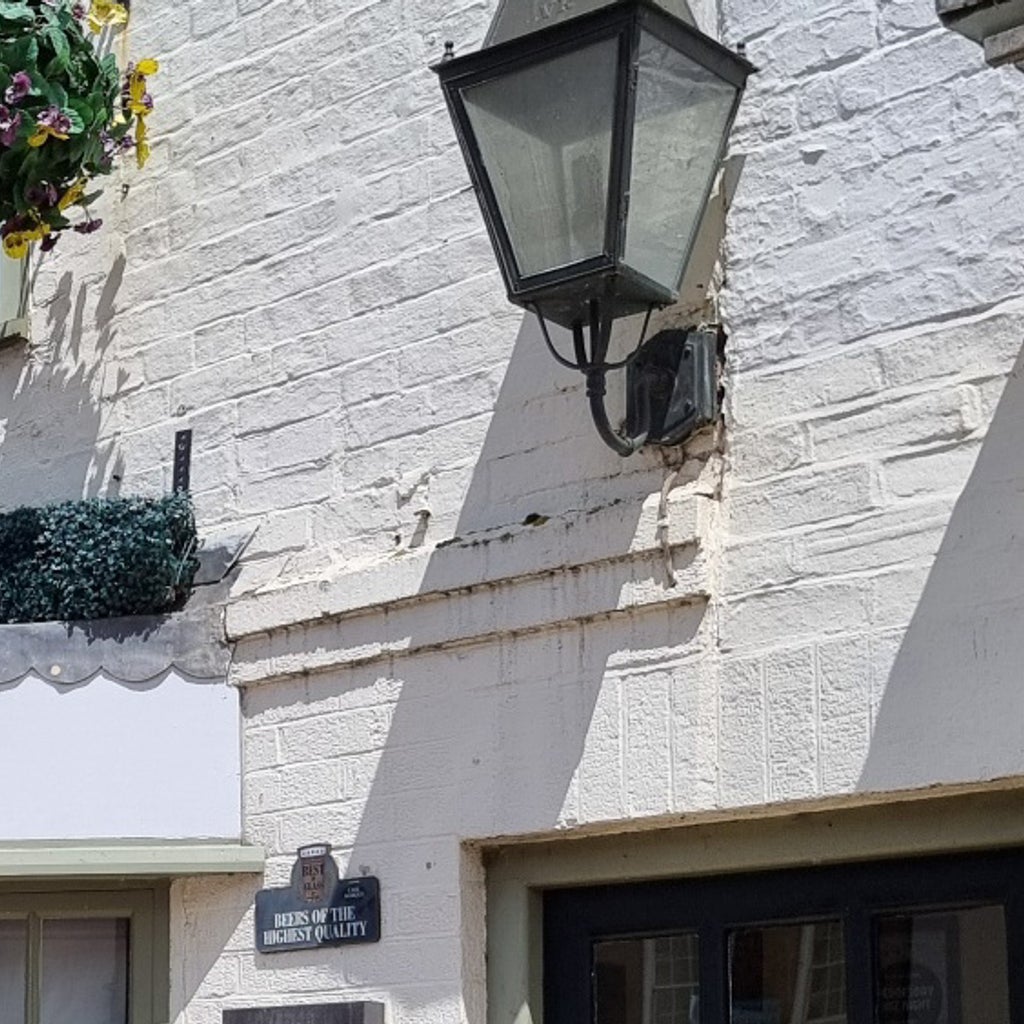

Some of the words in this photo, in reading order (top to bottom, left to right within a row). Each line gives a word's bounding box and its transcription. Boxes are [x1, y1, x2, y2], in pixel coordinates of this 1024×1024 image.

[274, 911, 309, 928] BEERS
[311, 907, 328, 923] OF
[331, 906, 356, 922] THE
[263, 926, 313, 945] HIGHEST
[315, 921, 367, 943] QUALITY
